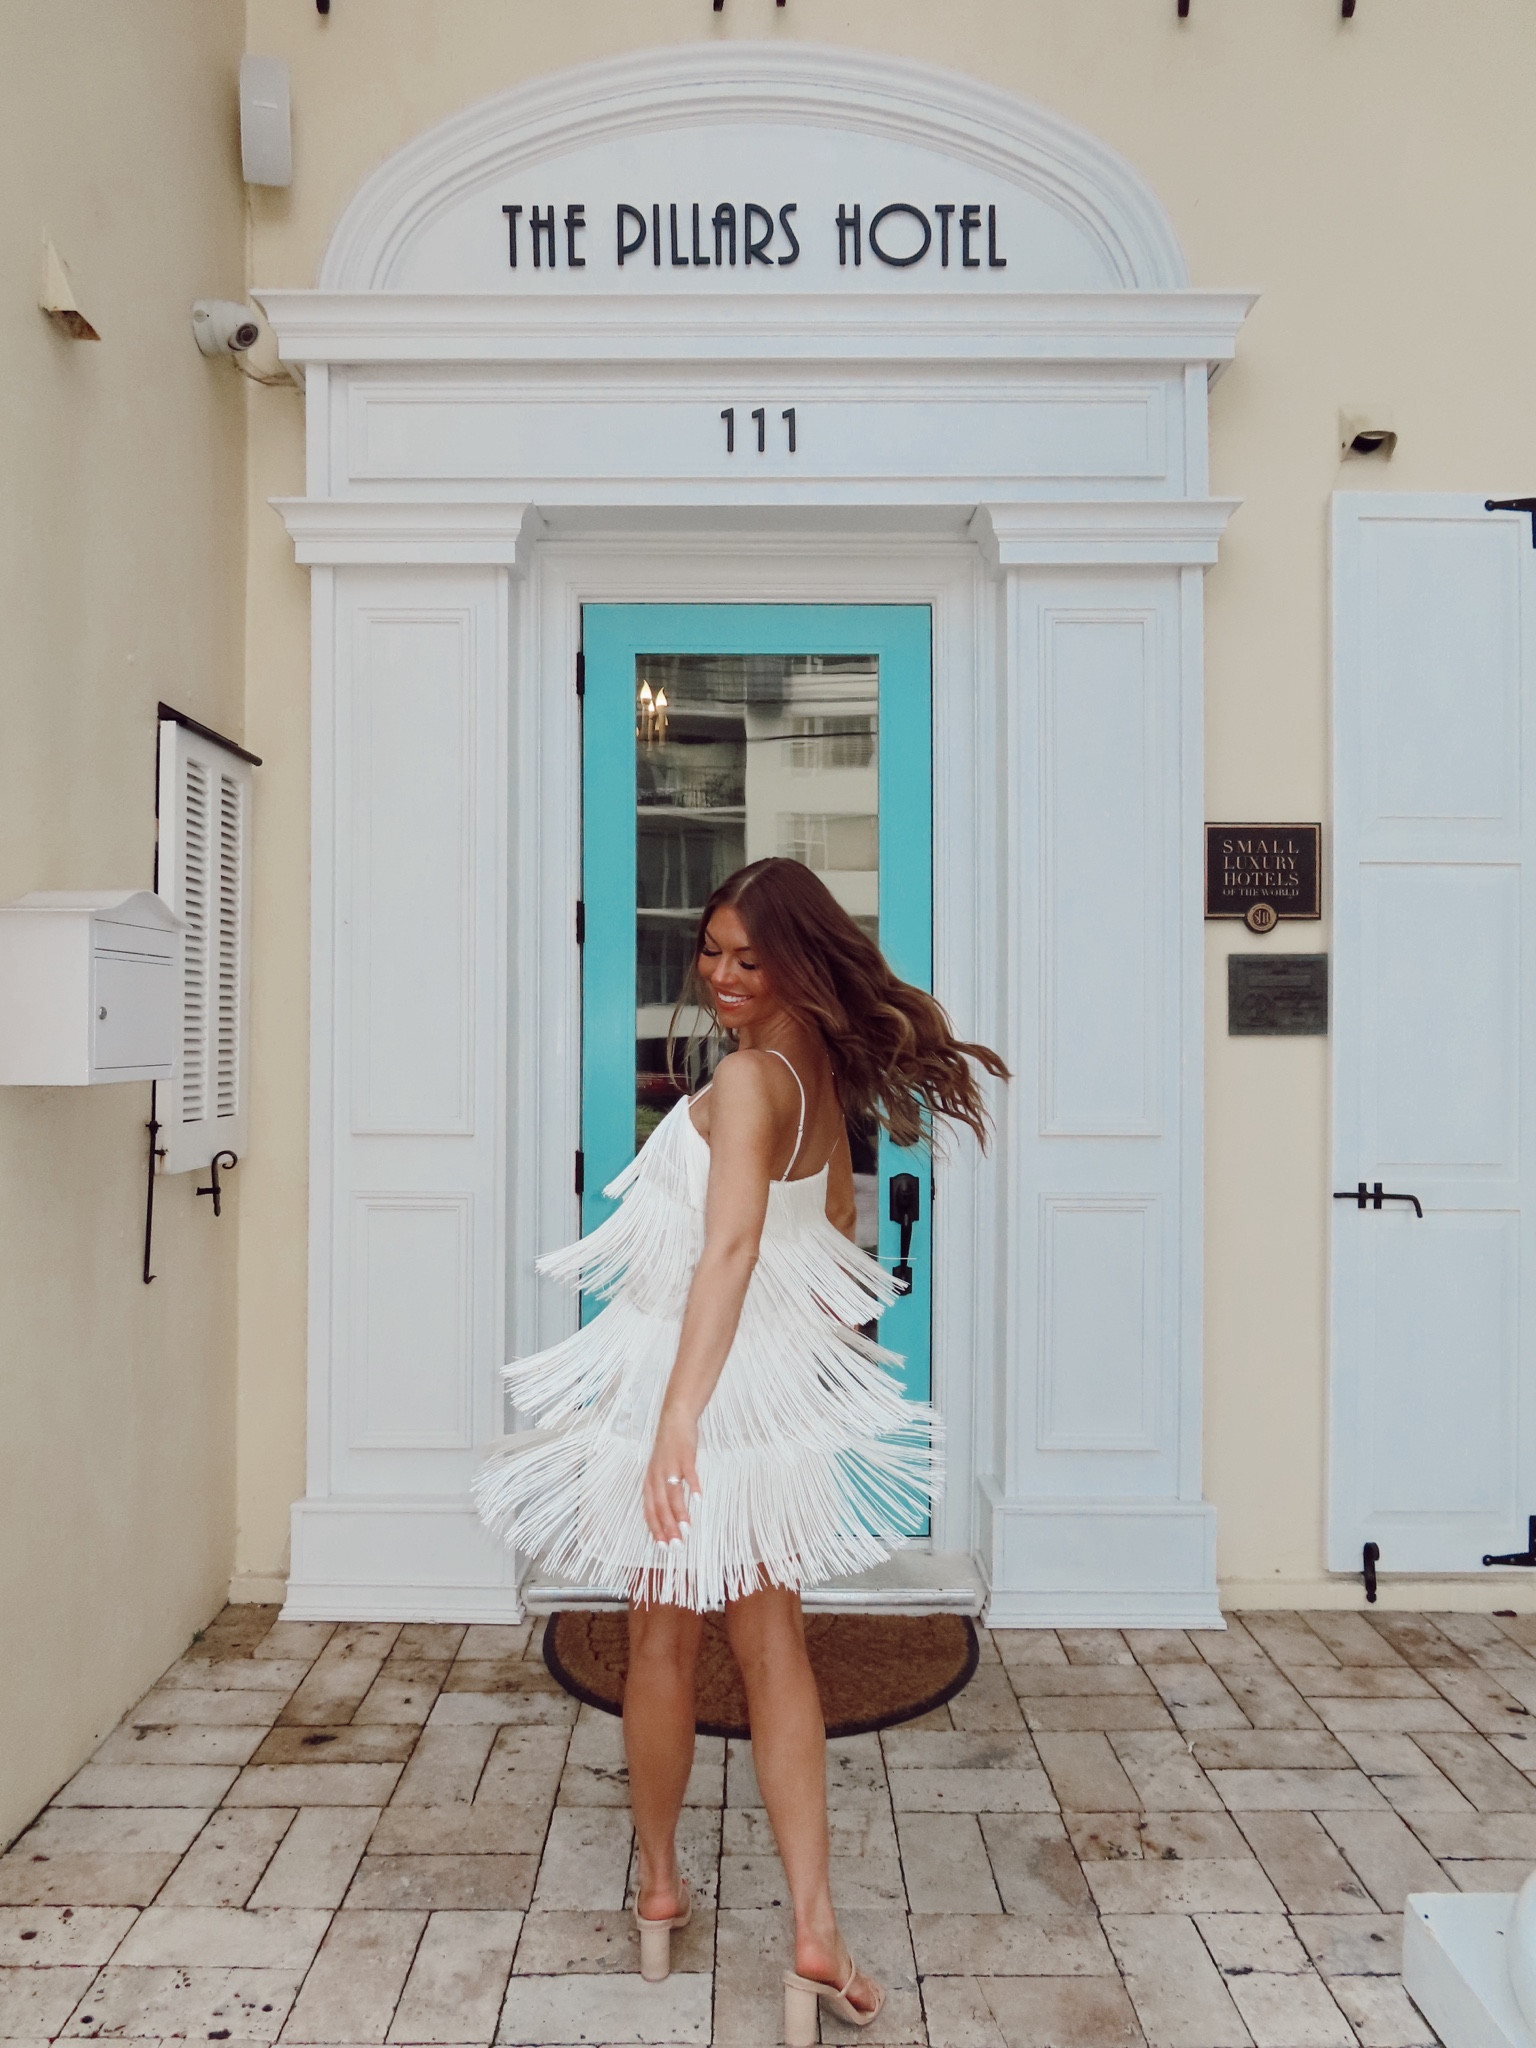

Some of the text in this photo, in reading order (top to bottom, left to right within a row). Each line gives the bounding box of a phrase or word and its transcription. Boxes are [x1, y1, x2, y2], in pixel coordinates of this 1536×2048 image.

[502, 202, 1007, 268] THE PILLARS HOTEL
[720, 407, 797, 453] 111
[1222, 839, 1299, 854] SMALL
[1223, 856, 1297, 870] LUXURY
[1224, 872, 1299, 886] HOTELS
[1222, 888, 1299, 897] OF THE WORLD
